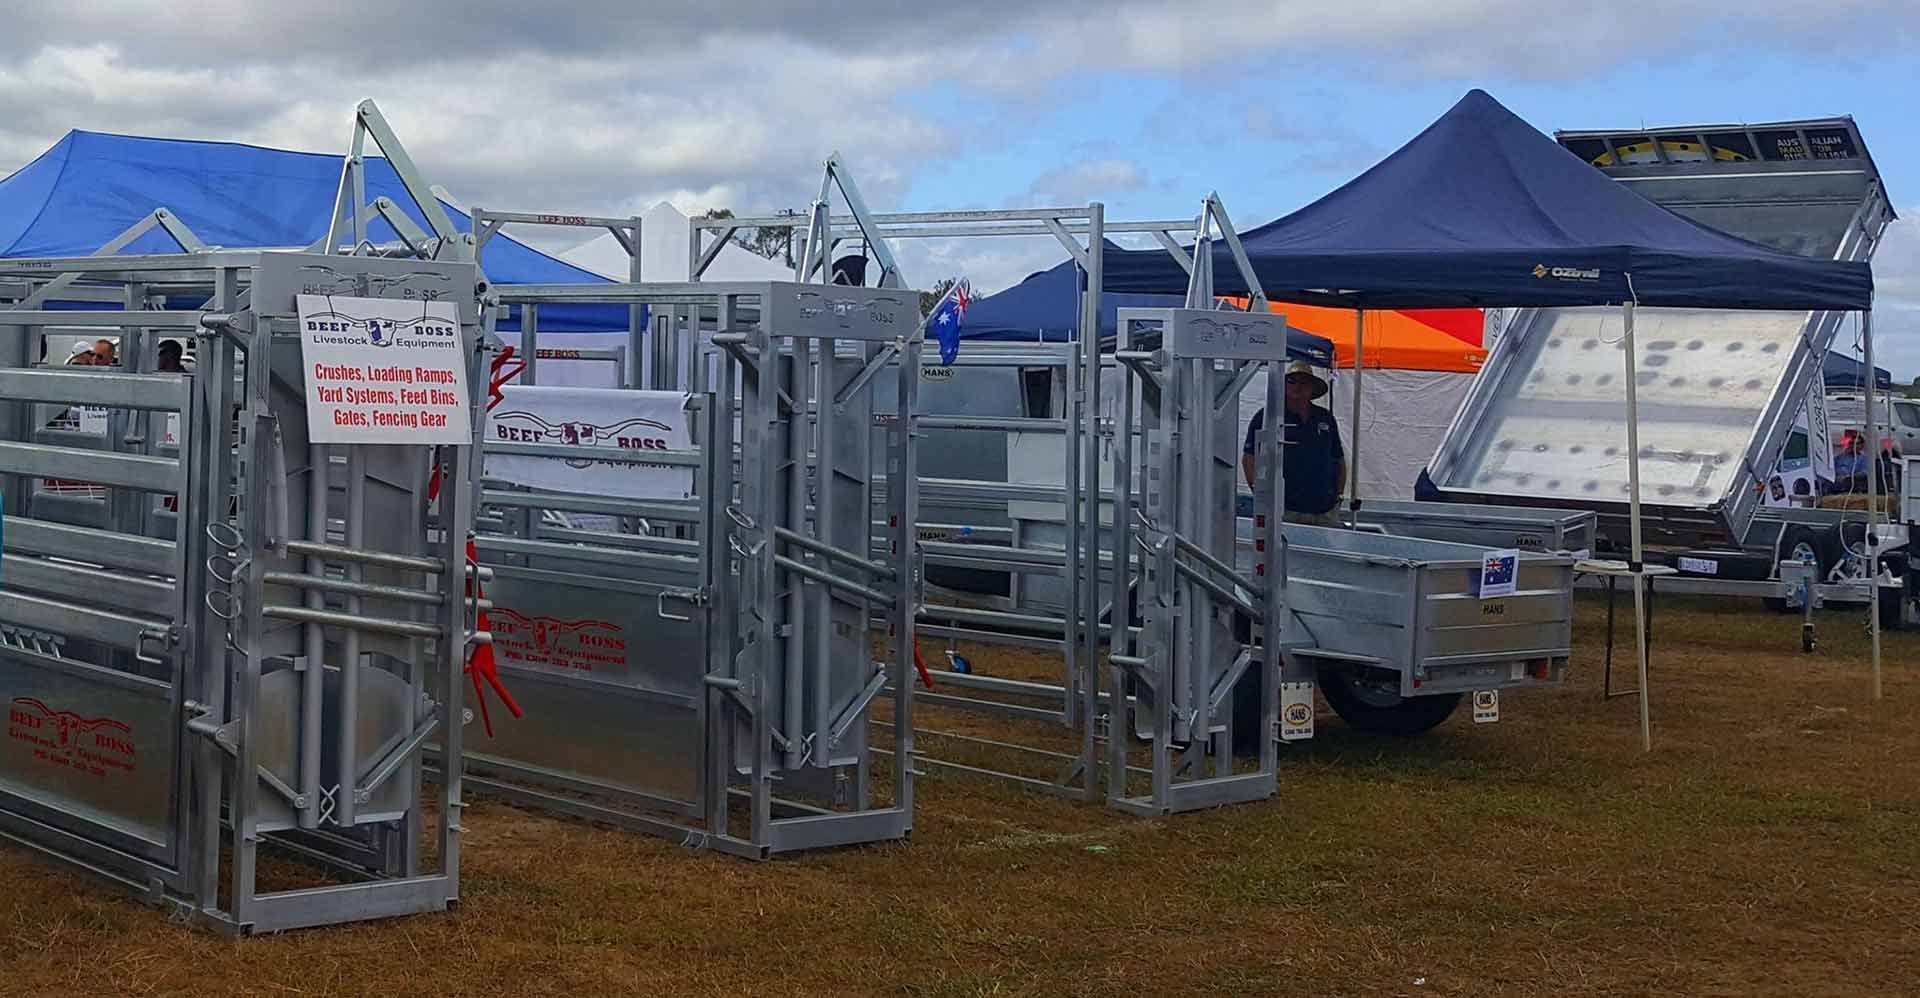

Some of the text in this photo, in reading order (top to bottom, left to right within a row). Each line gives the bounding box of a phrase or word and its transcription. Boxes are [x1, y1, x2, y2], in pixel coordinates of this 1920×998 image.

[307, 321, 454, 337] BEEF BOSS
[313, 335, 456, 350] Livestock Equipment
[536, 349, 553, 359] EEF
[315, 363, 457, 385] Crushes, Loading Ramps,
[924, 369, 951, 377] HANS
[317, 386, 459, 407] Yard Systems, Feed Bins,
[334, 409, 447, 428] Gates, Fencing Gear
[496, 424, 668, 450] BEEF BOSS
[579, 634, 625, 650] BOSS
[95, 734, 135, 755] BOSS
